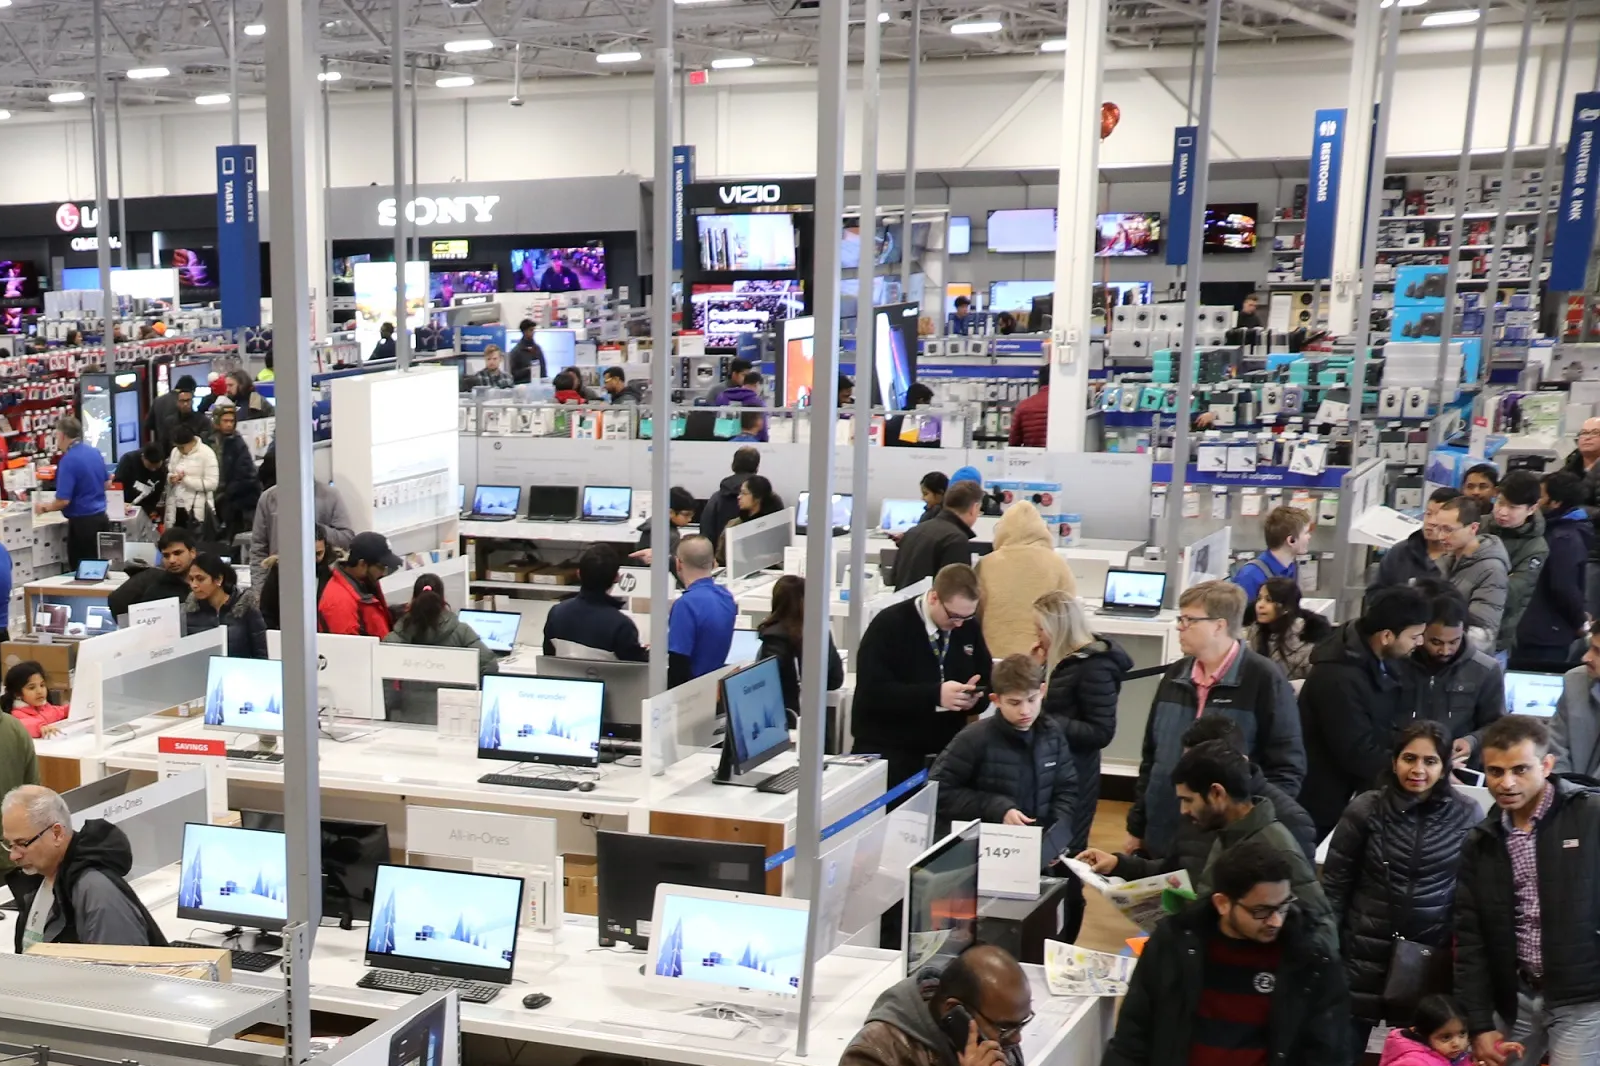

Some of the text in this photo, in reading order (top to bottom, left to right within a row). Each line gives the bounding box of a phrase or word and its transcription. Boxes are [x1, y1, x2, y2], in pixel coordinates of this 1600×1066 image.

[1178, 153, 1188, 179] SMALL
[1317, 142, 1331, 202] RESTROOMS
[1568, 130, 1593, 222] PRINTERS & INK
[224, 180, 235, 223] TABLETS
[246, 179, 254, 222] TABLETS
[675, 169, 683, 241] VIDEO COMPONENTS
[719, 184, 781, 204] VIZIO
[377, 195, 500, 226] SONY
[174, 742, 209, 752] SAVINGS
[103, 796, 143, 818] All-in-Ones
[449, 828, 510, 847] All-in-Ones
